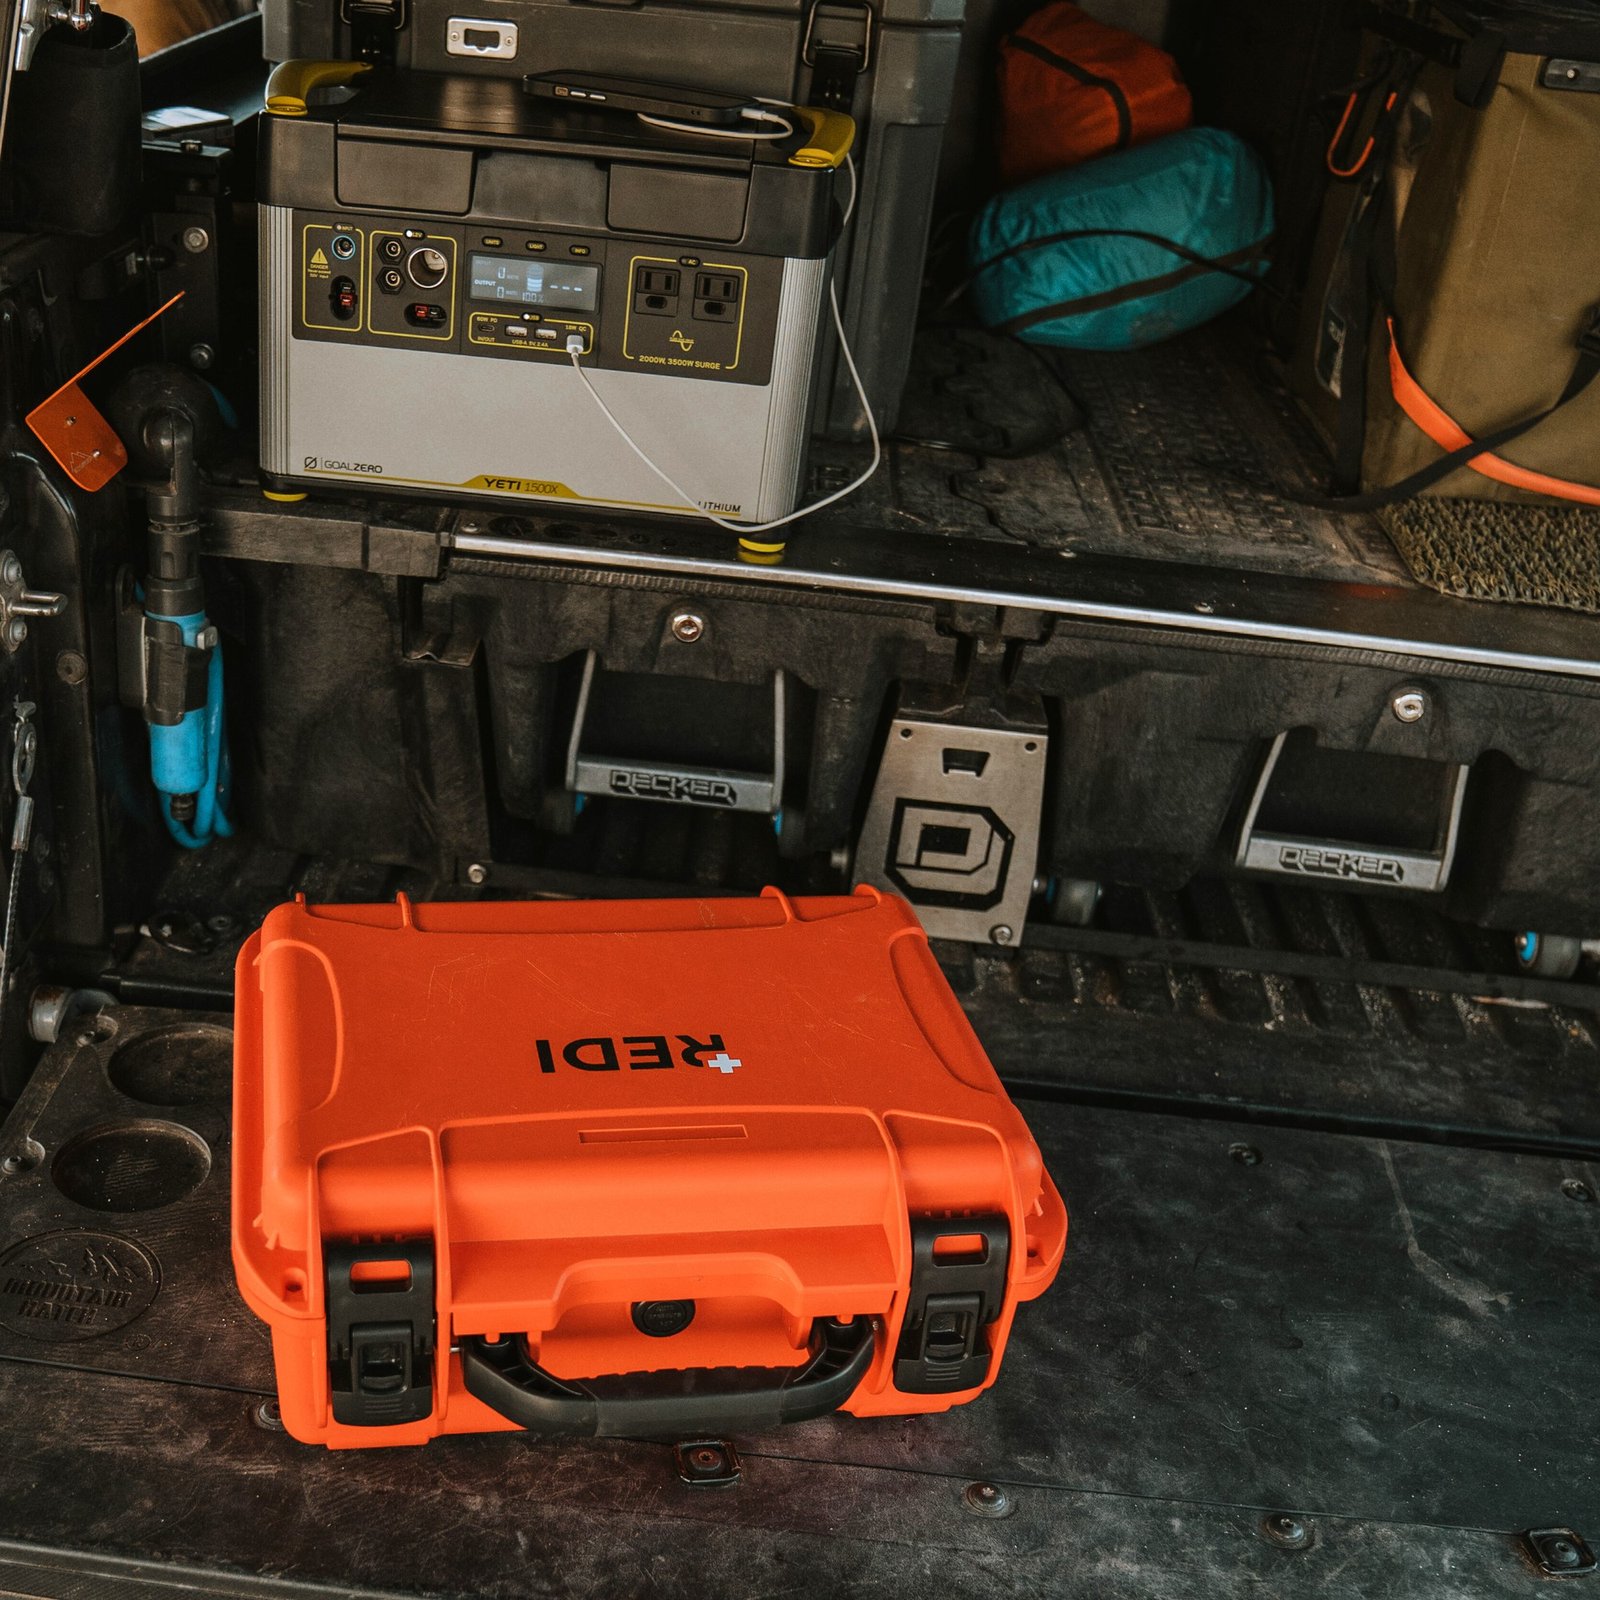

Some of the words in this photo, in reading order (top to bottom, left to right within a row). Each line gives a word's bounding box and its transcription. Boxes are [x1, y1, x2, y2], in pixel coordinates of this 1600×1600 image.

[474, 279, 497, 287] OUTPUT
[639, 355, 666, 364] 2000W,
[667, 359, 694, 367] 3500W
[695, 361, 721, 370] SURGE
[484, 478, 521, 490] YETI
[524, 482, 558, 494] 1500X
[610, 769, 737, 805] DECKED
[1279, 846, 1404, 882] DECKED
[535, 1034, 726, 1074] REDI
[3, 1278, 132, 1308] MOUNTAIN
[18, 1299, 99, 1324] HATCH
